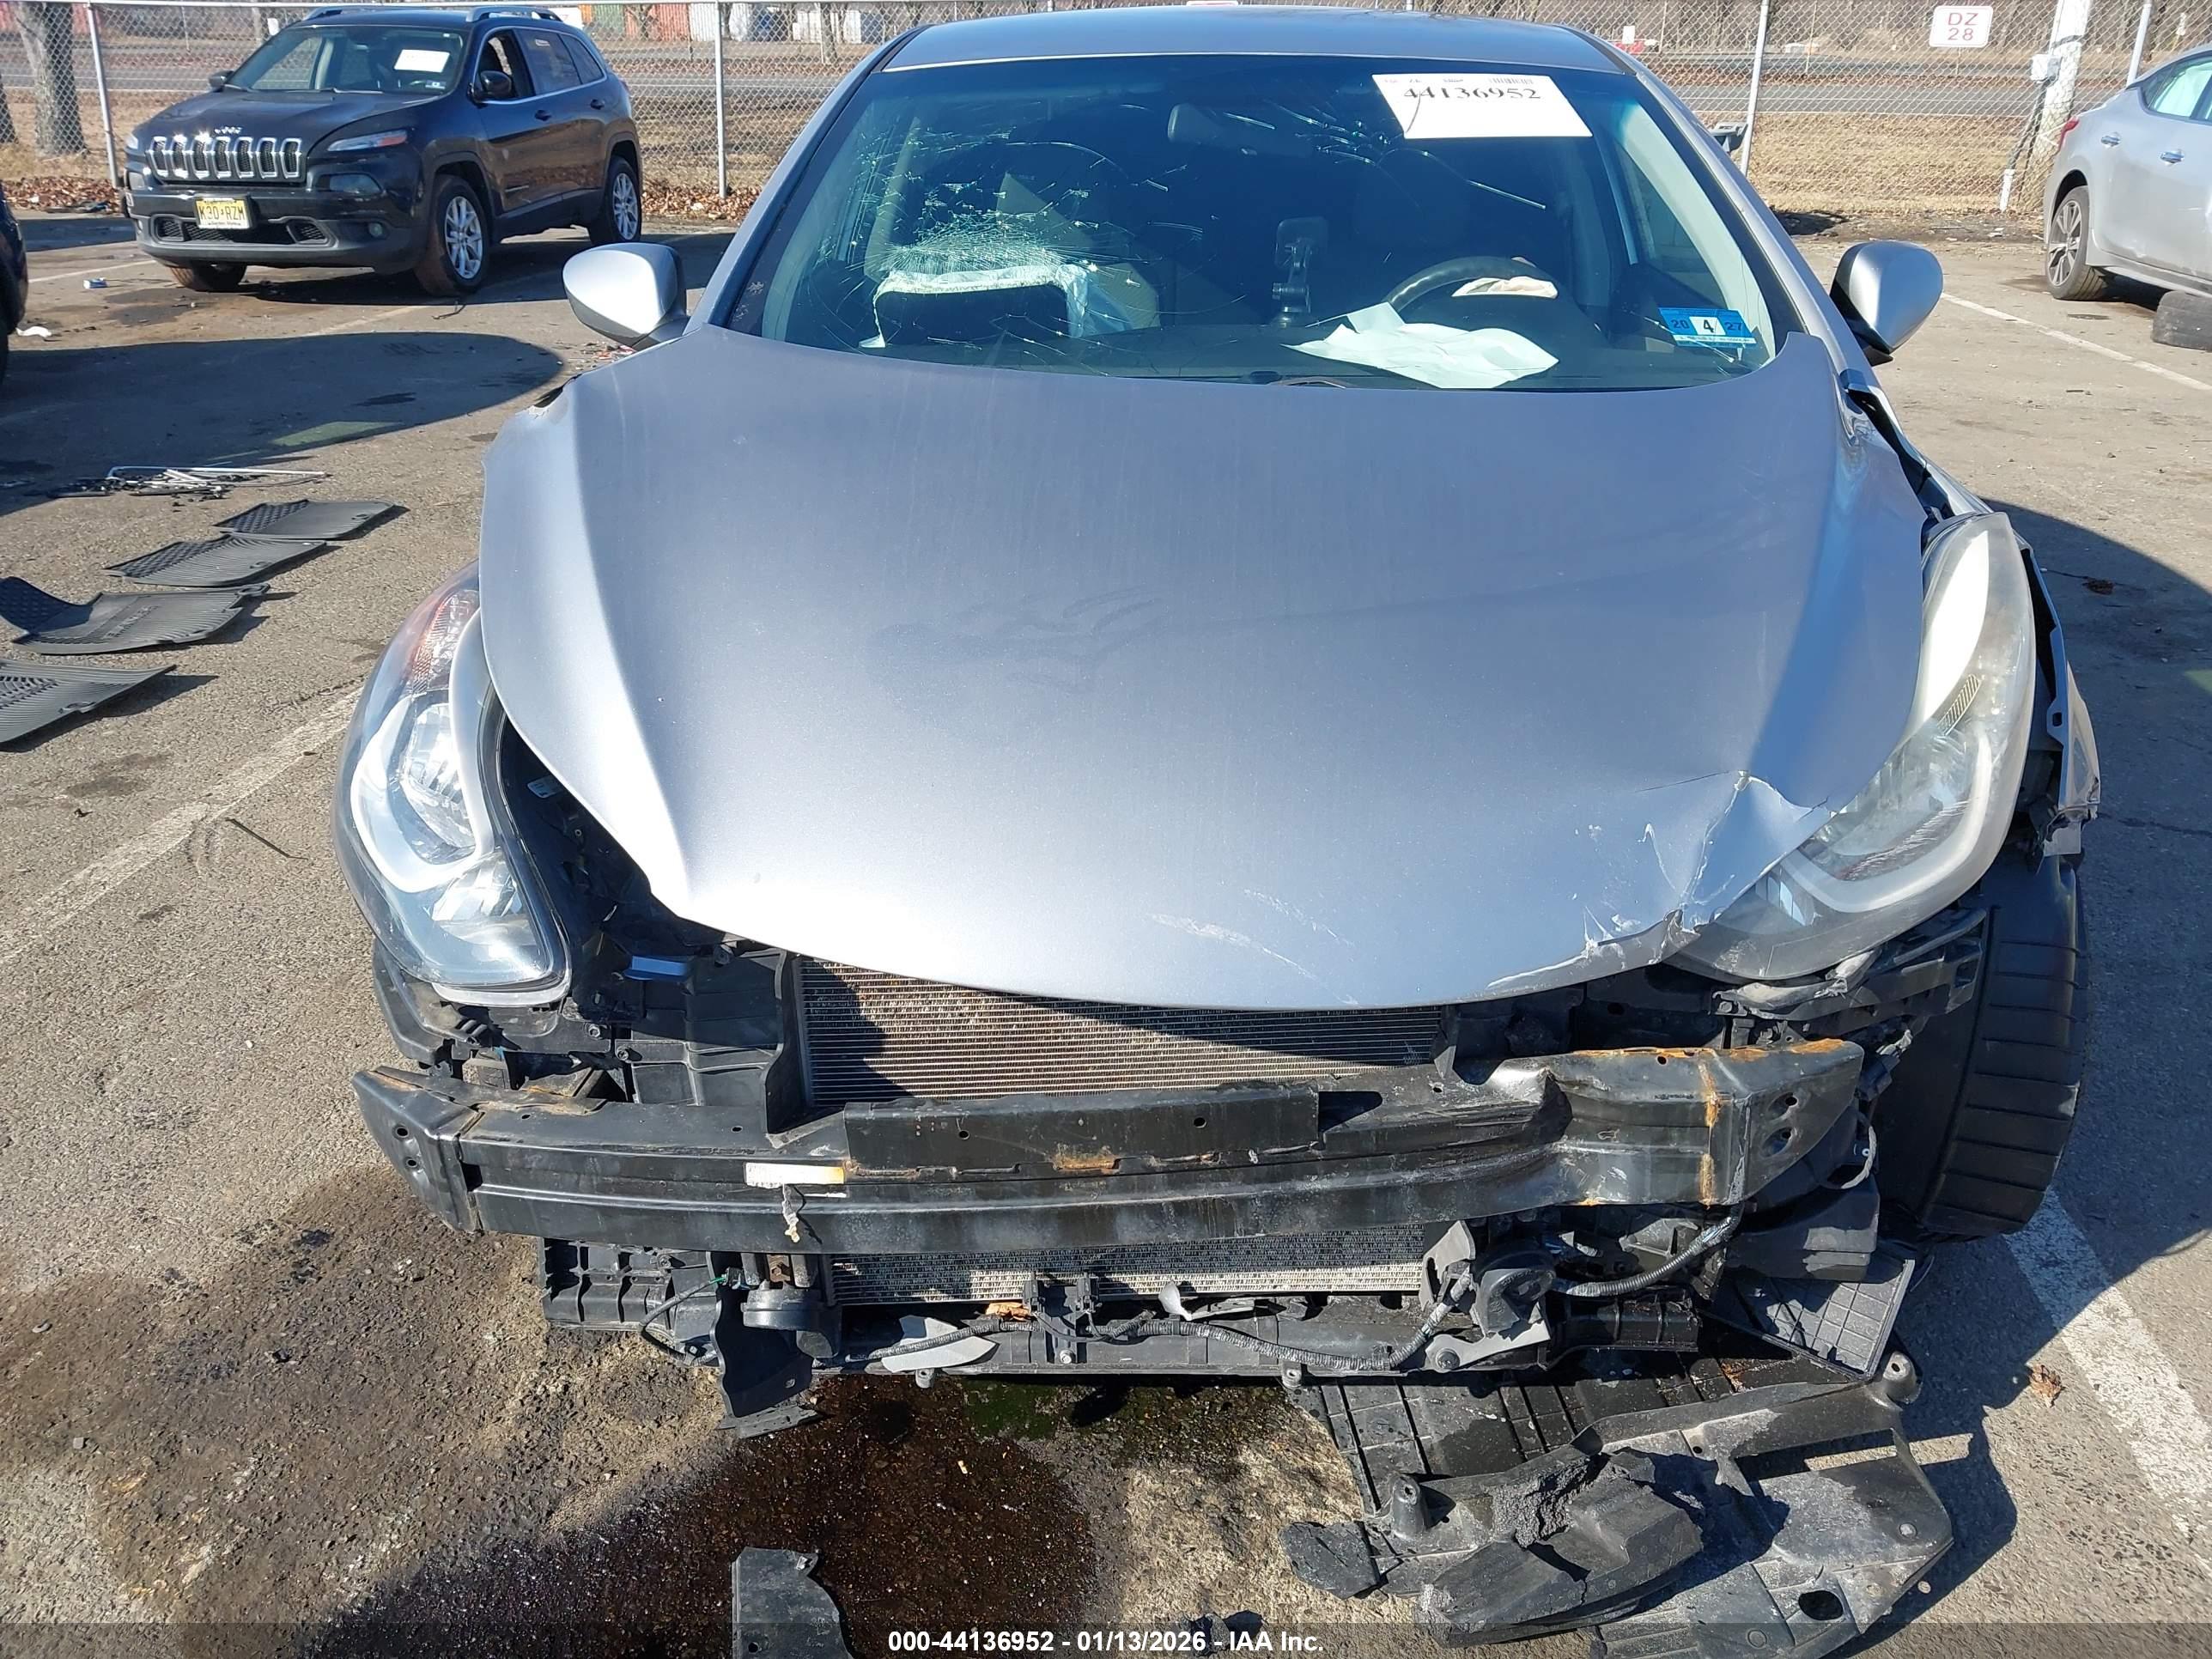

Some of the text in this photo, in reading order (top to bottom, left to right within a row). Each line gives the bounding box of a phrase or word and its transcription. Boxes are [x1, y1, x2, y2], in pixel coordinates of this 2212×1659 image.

[1947, 12, 1979, 26] DZ
[1947, 27, 1974, 41] 28
[1403, 86, 1541, 99] 44136952
[1703, 319, 1715, 333] 4
